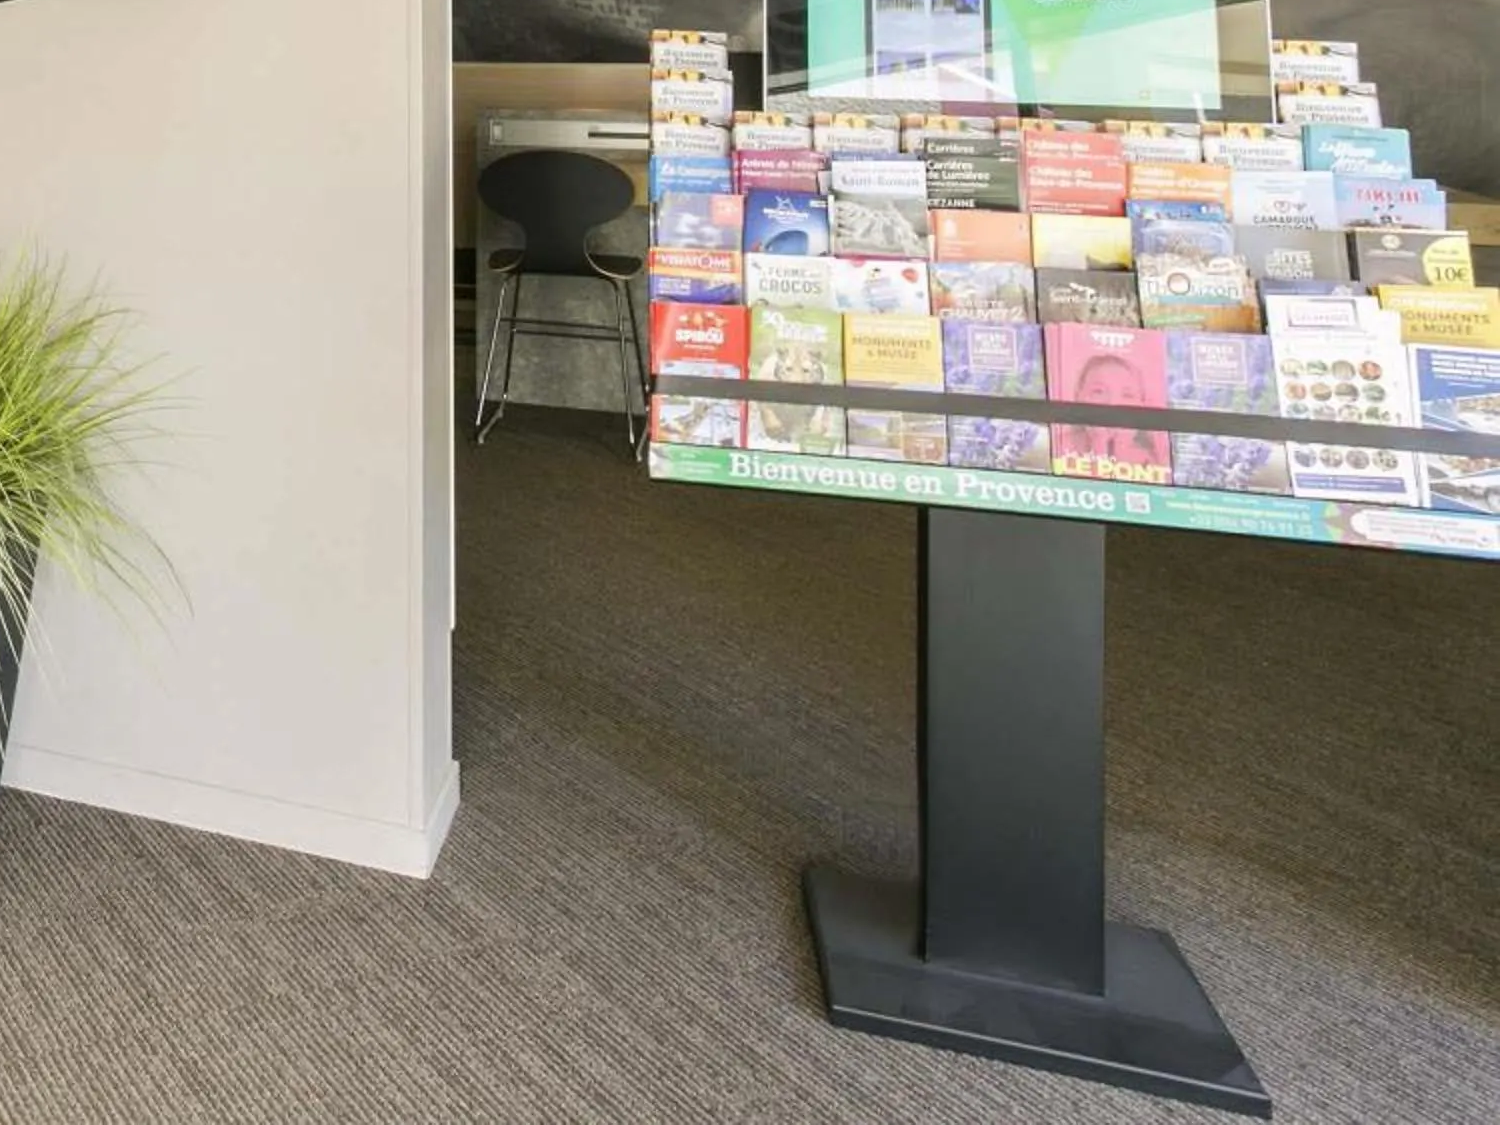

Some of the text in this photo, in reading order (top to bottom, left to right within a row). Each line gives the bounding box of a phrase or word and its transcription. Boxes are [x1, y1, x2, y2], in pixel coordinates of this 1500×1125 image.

[927, 160, 974, 172] Carrières
[943, 170, 991, 182] Lumières
[1253, 211, 1315, 225] CAMARGUE
[1434, 266, 1469, 282] 10€
[760, 279, 822, 294] CROCOS
[851, 335, 932, 350] MONUMENTS
[1063, 455, 1171, 484] LE PONT
[728, 450, 897, 492] Bienvenue
[904, 474, 944, 497] en
[954, 471, 1116, 512] Provence
